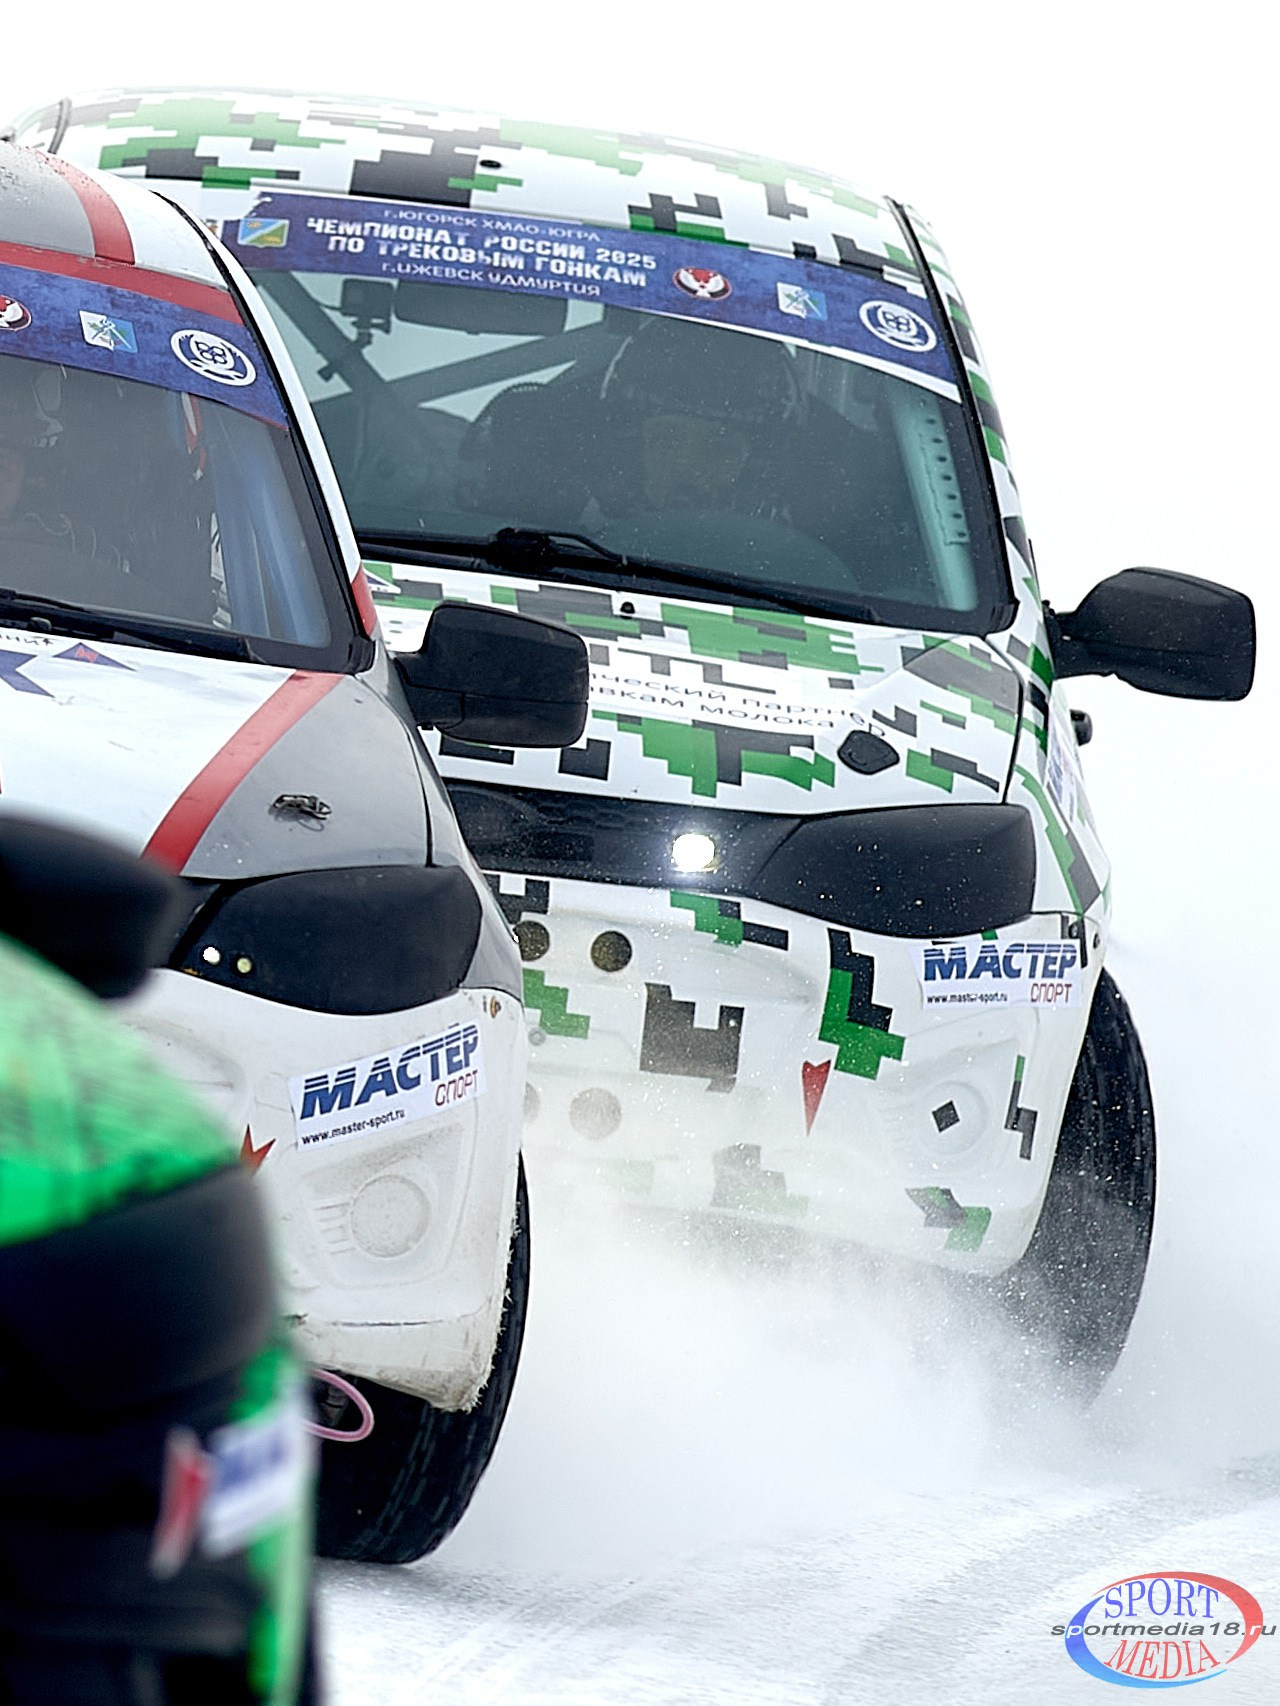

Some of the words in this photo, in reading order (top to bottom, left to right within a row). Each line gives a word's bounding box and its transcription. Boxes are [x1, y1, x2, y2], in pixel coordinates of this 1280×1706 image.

[306, 217, 470, 246] ЧЕМПИОНАТ
[484, 235, 585, 261] РОССИИ
[596, 248, 657, 270] 2025
[327, 235, 365, 253] ПО
[376, 240, 525, 270] ТРЕКОВЫМ
[534, 257, 647, 287] ГОНКАМ
[590, 686, 684, 708] вкам
[700, 704, 834, 728] молока
[923, 942, 1078, 981] МАСТЕР
[1030, 983, 1072, 1004] СПОРТ
[299, 1024, 479, 1120] МАСТЕР
[435, 1069, 478, 1107] СПОРТ
[301, 1108, 405, 1146] www.master-sport.ru
